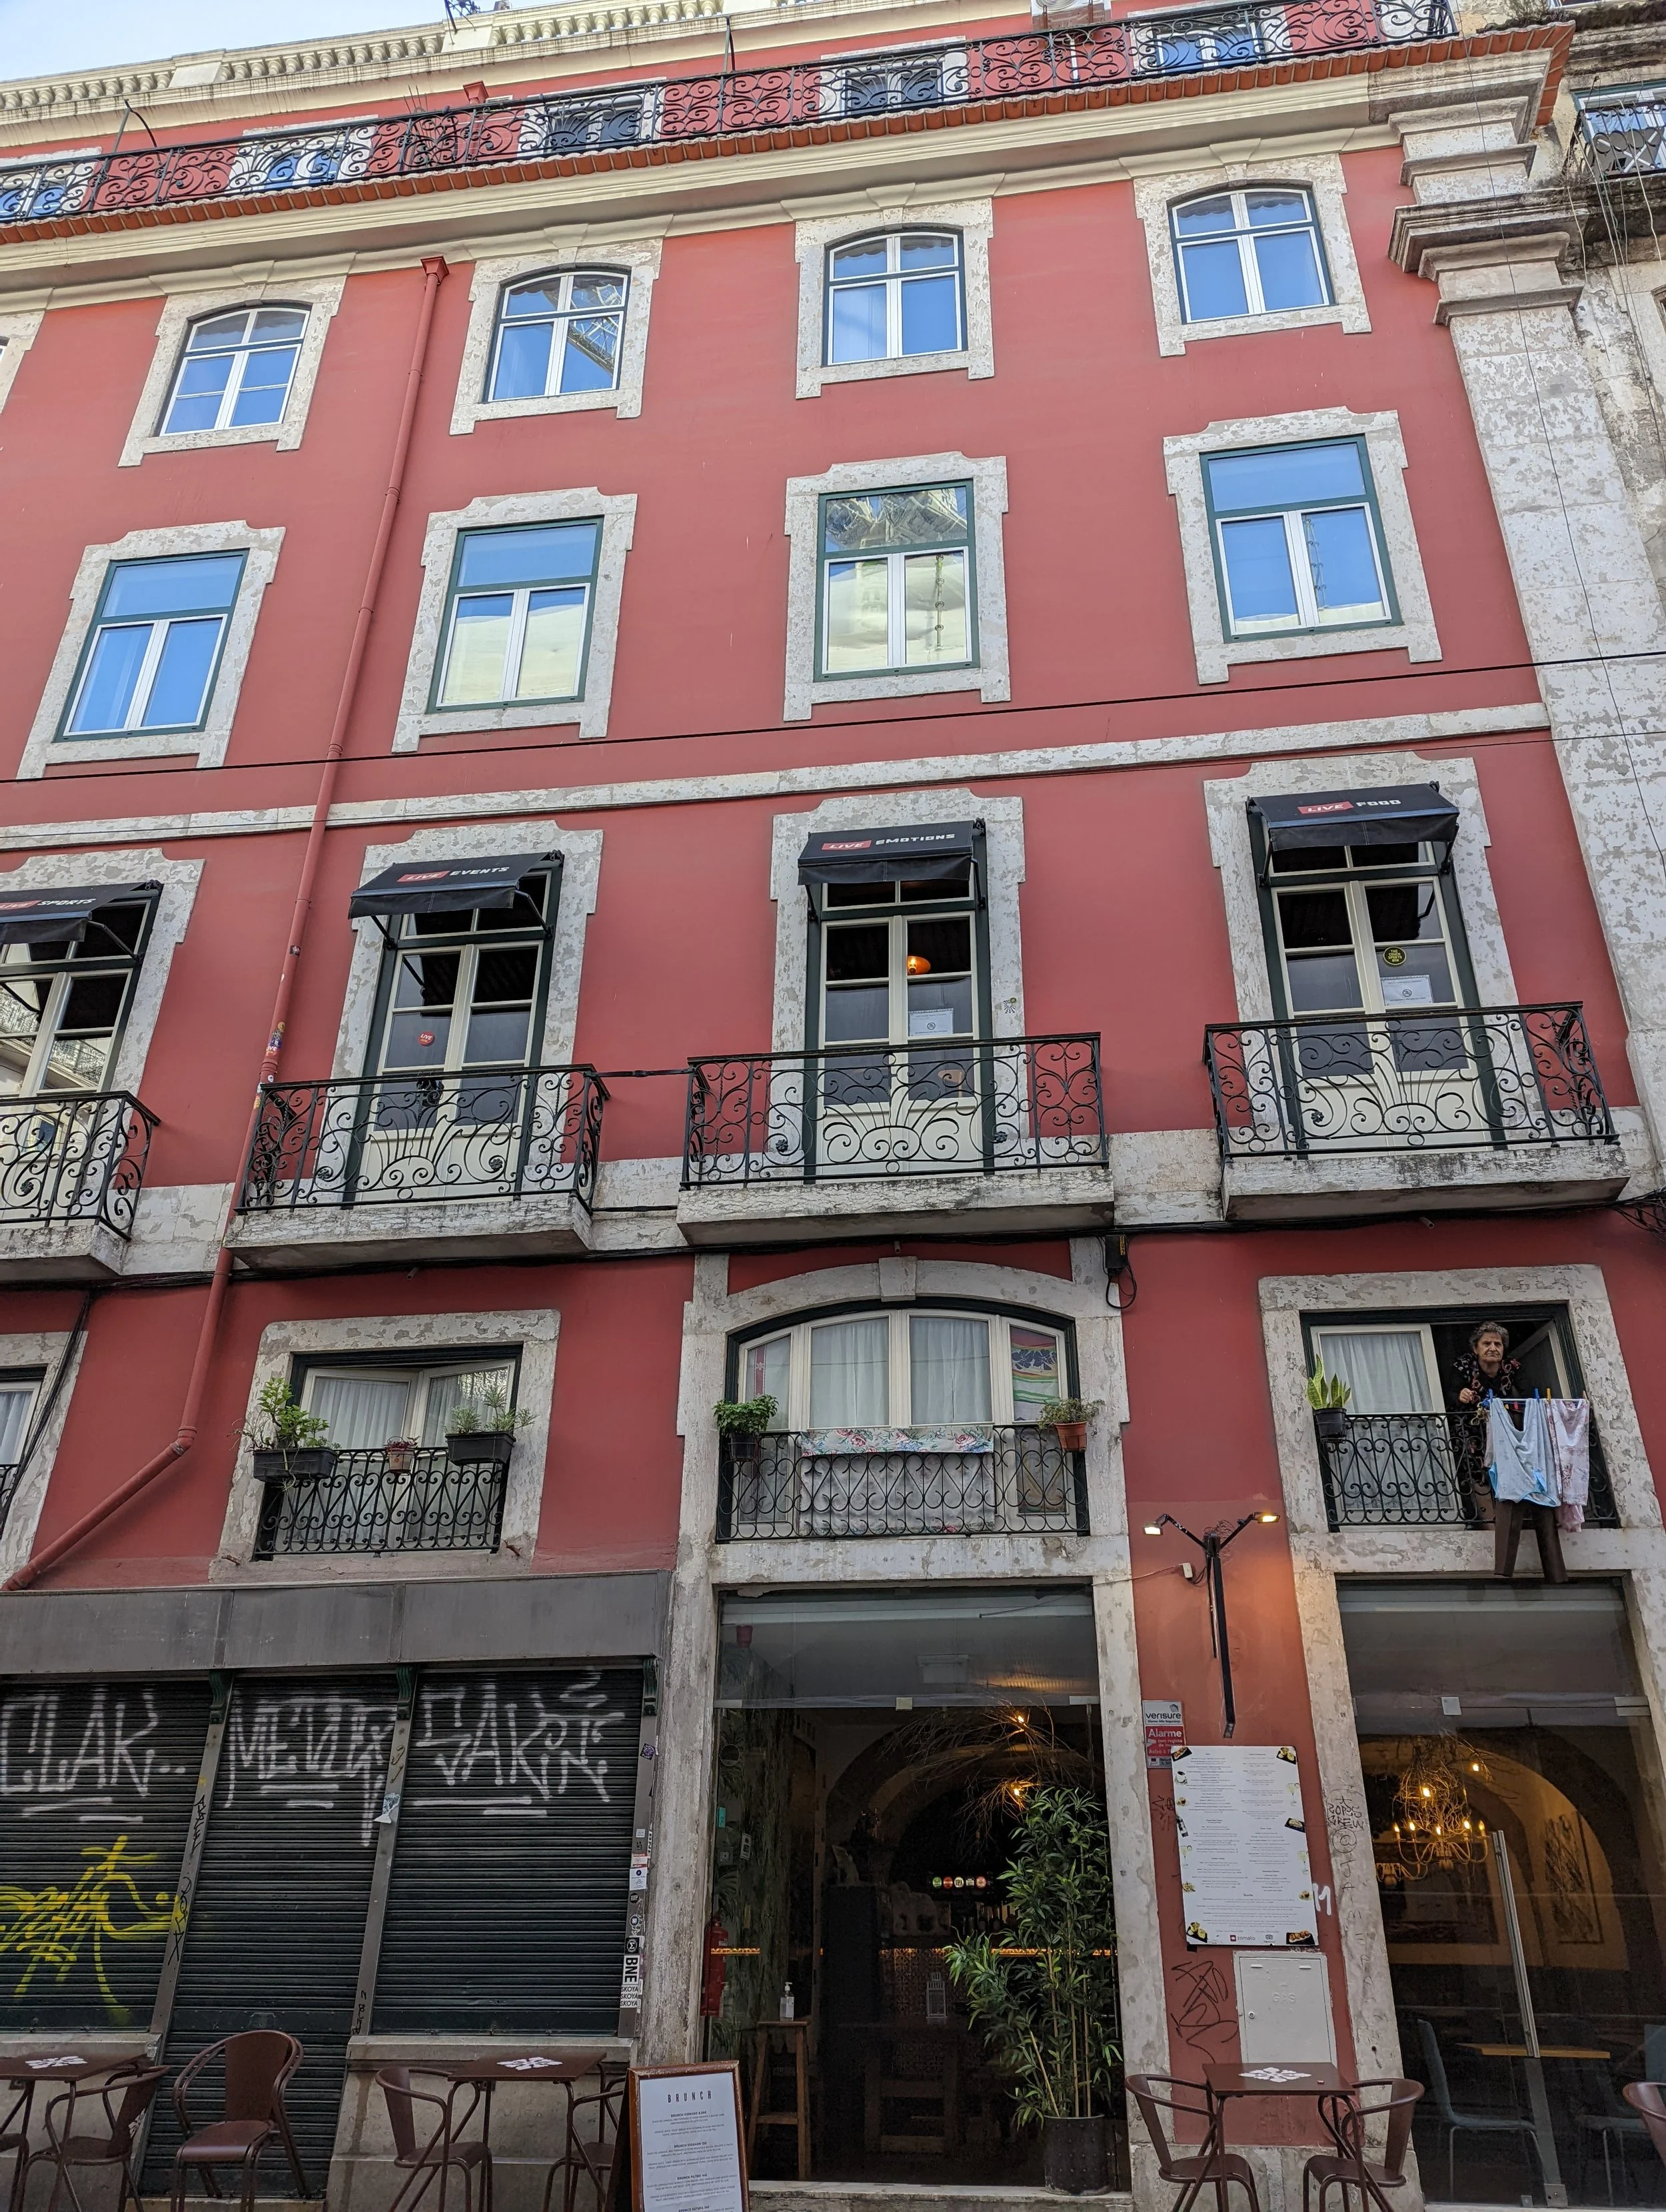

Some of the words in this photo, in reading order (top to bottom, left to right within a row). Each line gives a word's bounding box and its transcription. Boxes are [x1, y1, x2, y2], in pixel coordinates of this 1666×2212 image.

[1308, 804, 1344, 812] LIVE
[875, 833, 956, 845] EMOTIONS
[449, 866, 510, 876] EVENTS
[1149, 1729, 1182, 1737] Alarme
[624, 1957, 638, 1983] BNE
[1273, 1991, 1296, 2004] GAS
[668, 2090, 712, 2103] BRUNCH
